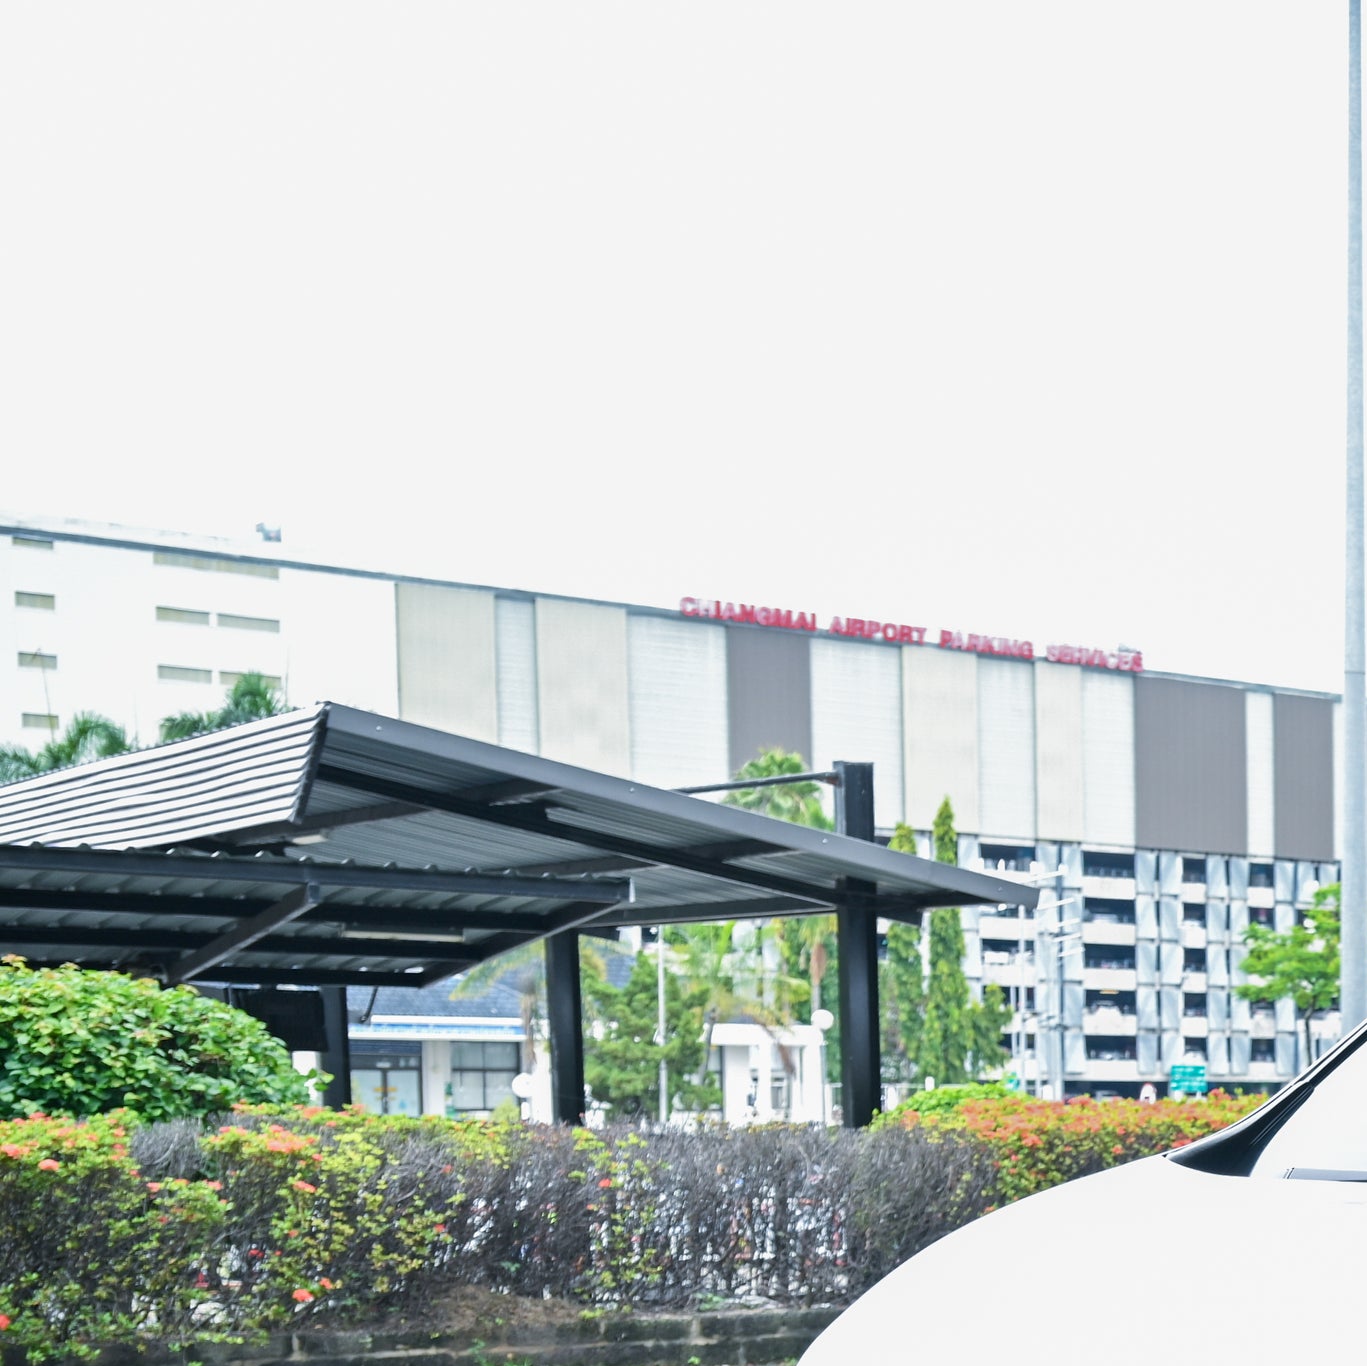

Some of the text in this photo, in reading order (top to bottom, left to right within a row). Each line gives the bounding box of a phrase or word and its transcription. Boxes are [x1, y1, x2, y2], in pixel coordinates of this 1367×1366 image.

[680, 597, 1144, 673] CHIANGMAI AIRPORT PARKING SERVICES
